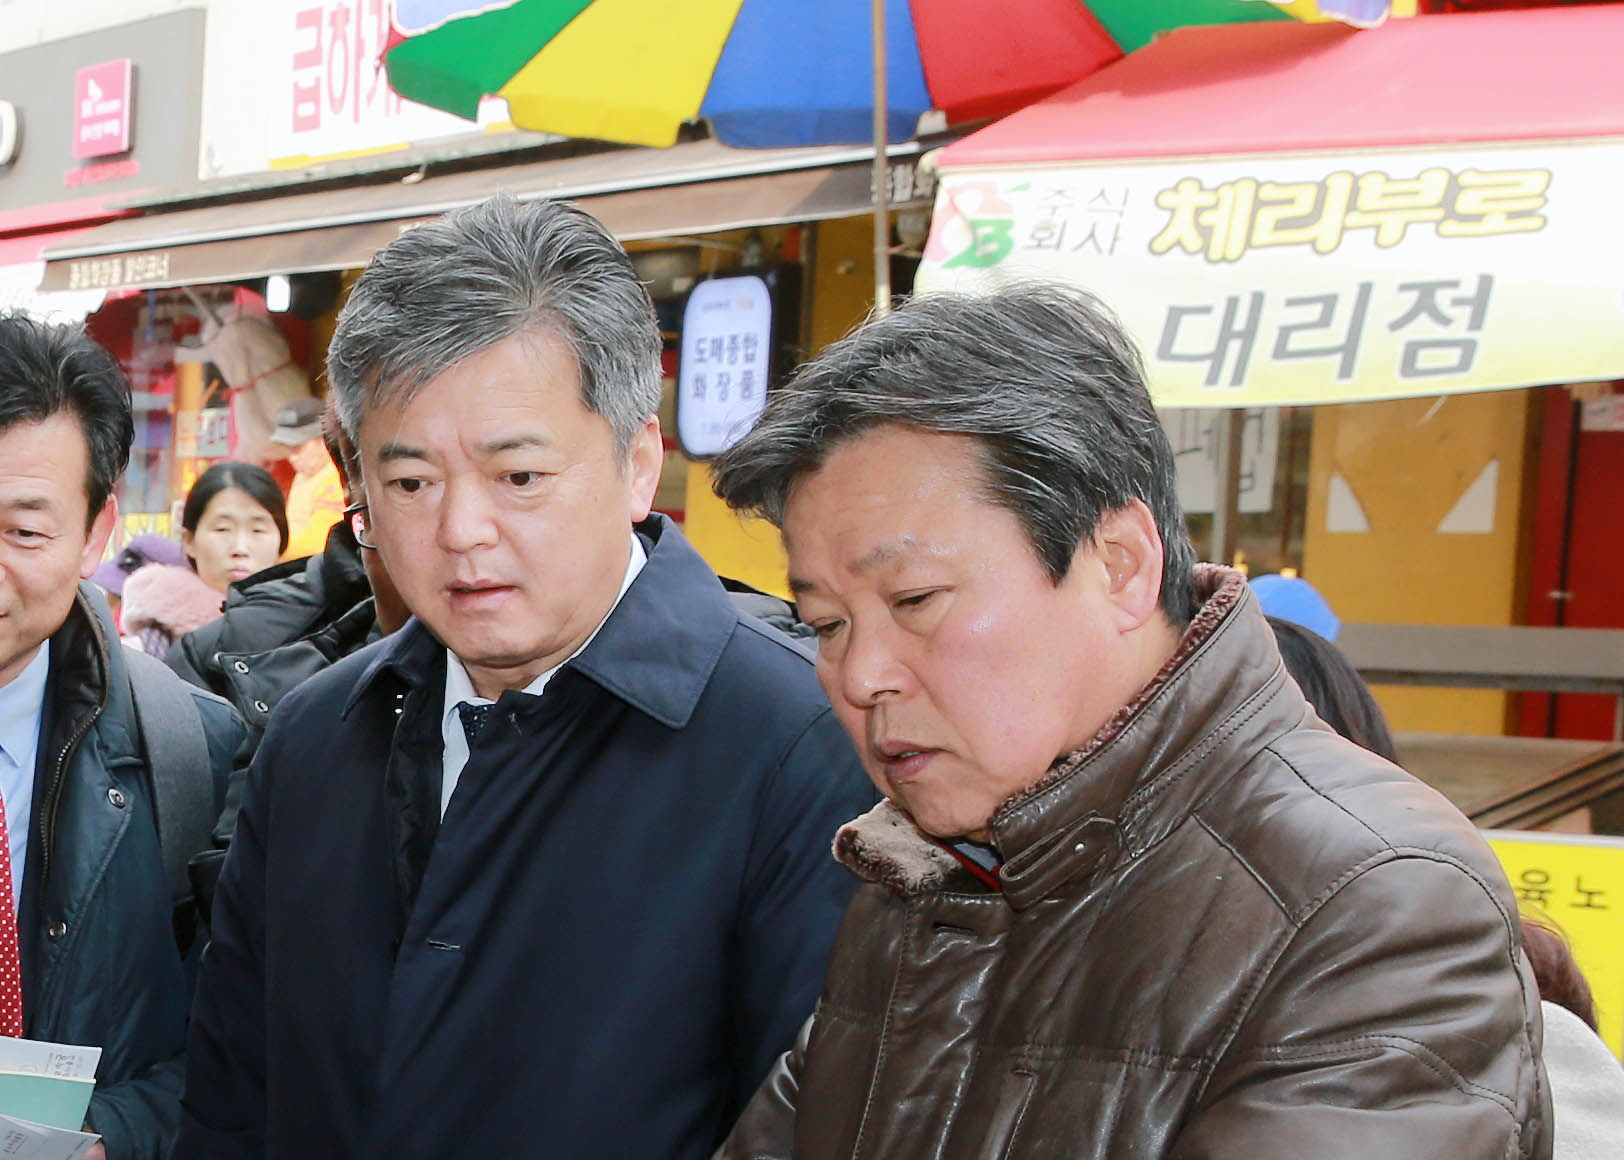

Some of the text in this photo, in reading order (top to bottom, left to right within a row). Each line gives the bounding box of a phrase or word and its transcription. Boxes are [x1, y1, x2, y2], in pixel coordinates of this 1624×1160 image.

[1037, 186, 1130, 218] 주식
[1149, 167, 1552, 263] 체리부로
[1022, 219, 1122, 256] 회사
[1155, 272, 1496, 388] 대리점
